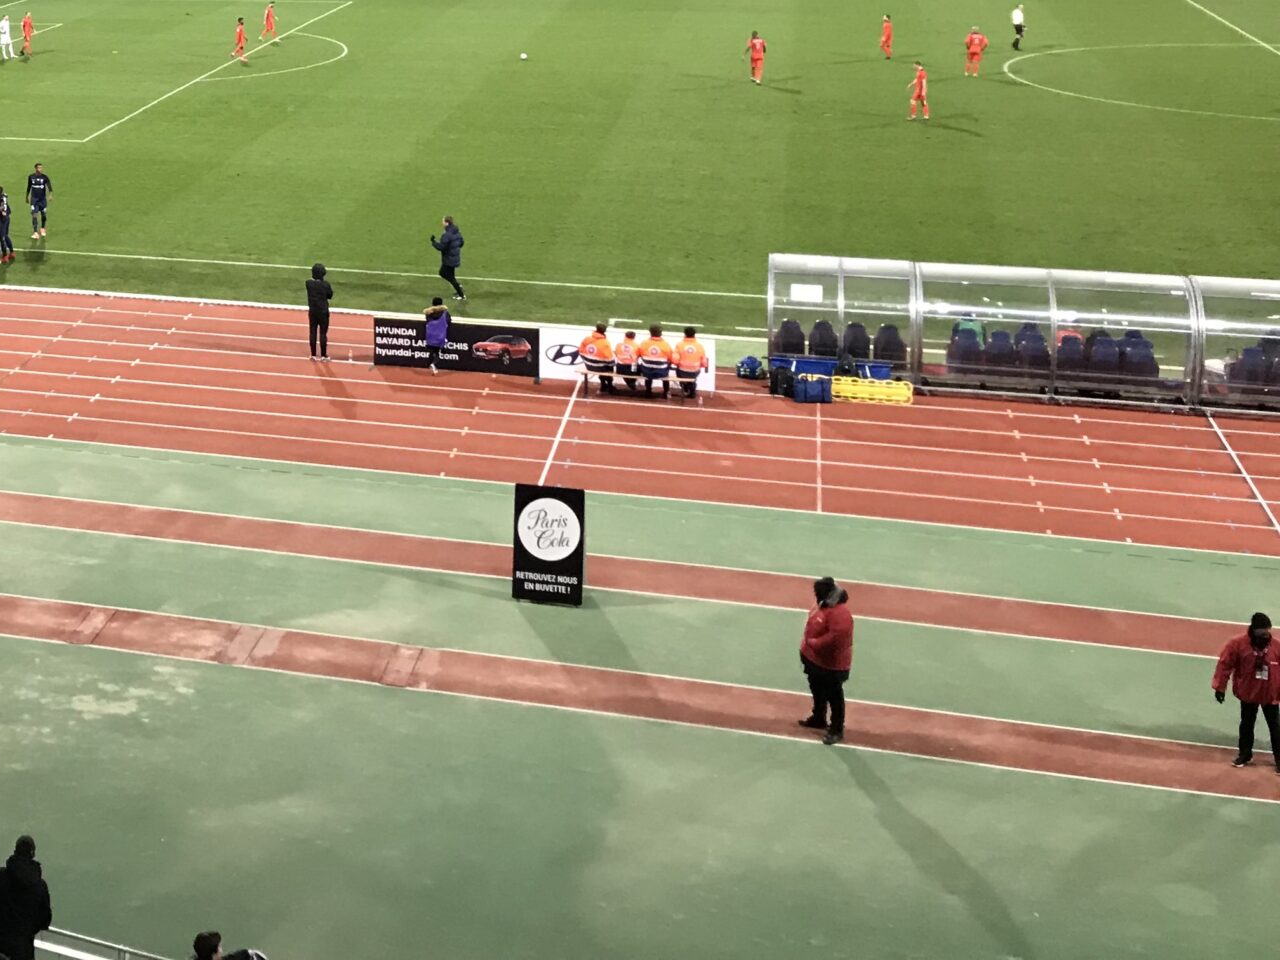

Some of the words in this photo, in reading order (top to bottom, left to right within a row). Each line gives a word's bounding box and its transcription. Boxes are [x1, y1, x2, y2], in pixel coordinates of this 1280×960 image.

[375, 326, 416, 336] HYUNDAI
[375, 336, 411, 346] BAYARD
[527, 508, 568, 531] Paris
[534, 529, 570, 550] Cola
[515, 570, 556, 582] RETROUVEZ
[557, 575, 578, 584] NOUS
[524, 581, 535, 590] EN
[535, 583, 566, 594] BUVETTE
